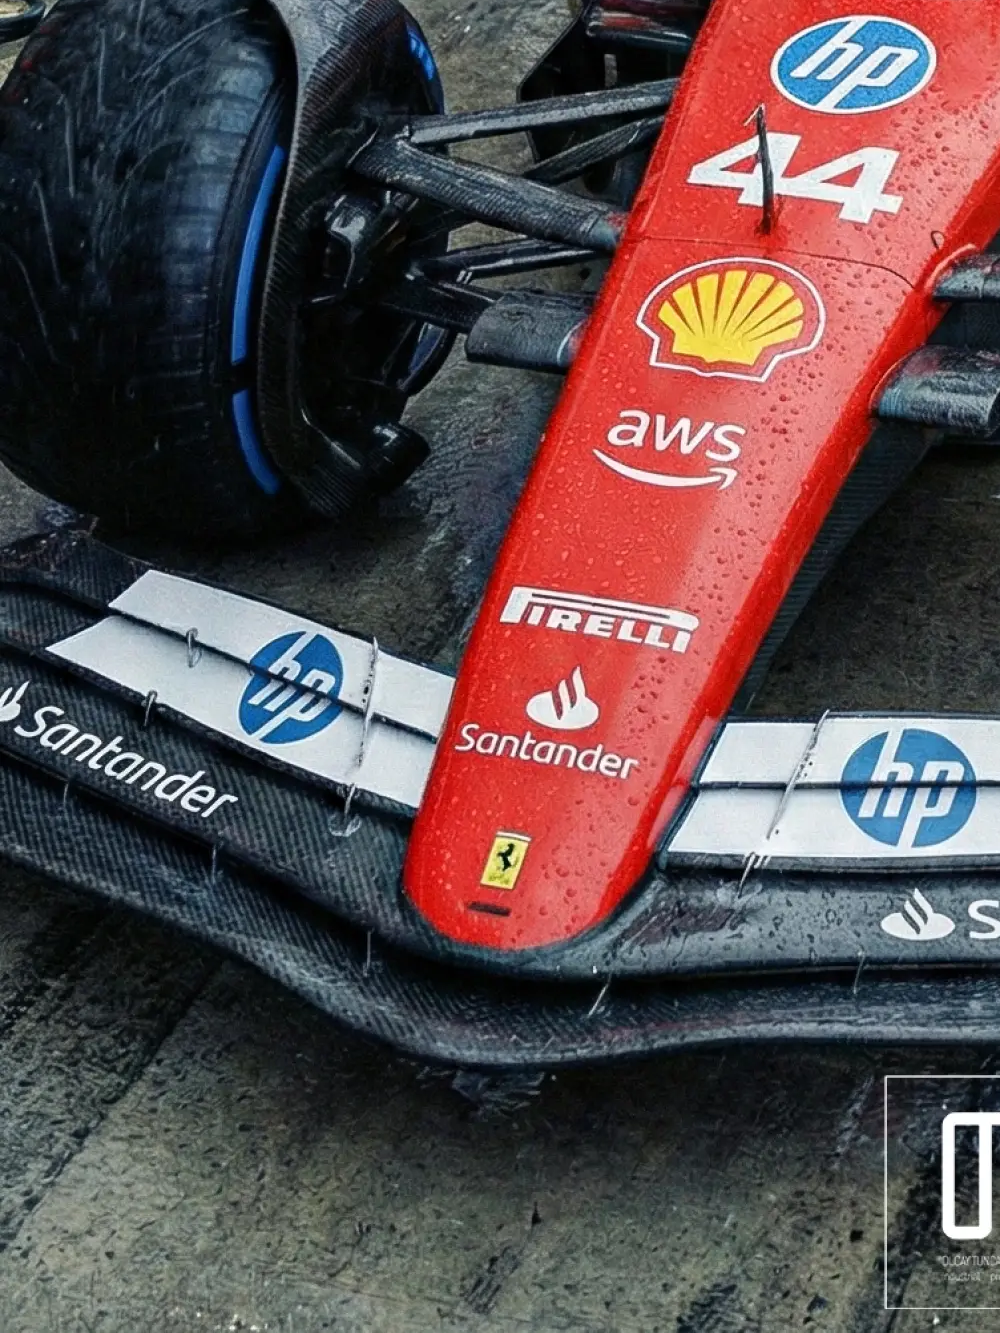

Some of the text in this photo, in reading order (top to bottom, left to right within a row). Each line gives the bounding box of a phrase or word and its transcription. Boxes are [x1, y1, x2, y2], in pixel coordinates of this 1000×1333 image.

[788, 16, 921, 111] hp
[686, 131, 905, 225] 44
[606, 408, 747, 464] aws
[499, 585, 700, 654] PIRELLI
[246, 629, 337, 742] hp
[13, 705, 239, 818] Santander
[454, 722, 640, 780] Santander
[856, 726, 966, 849] hp
